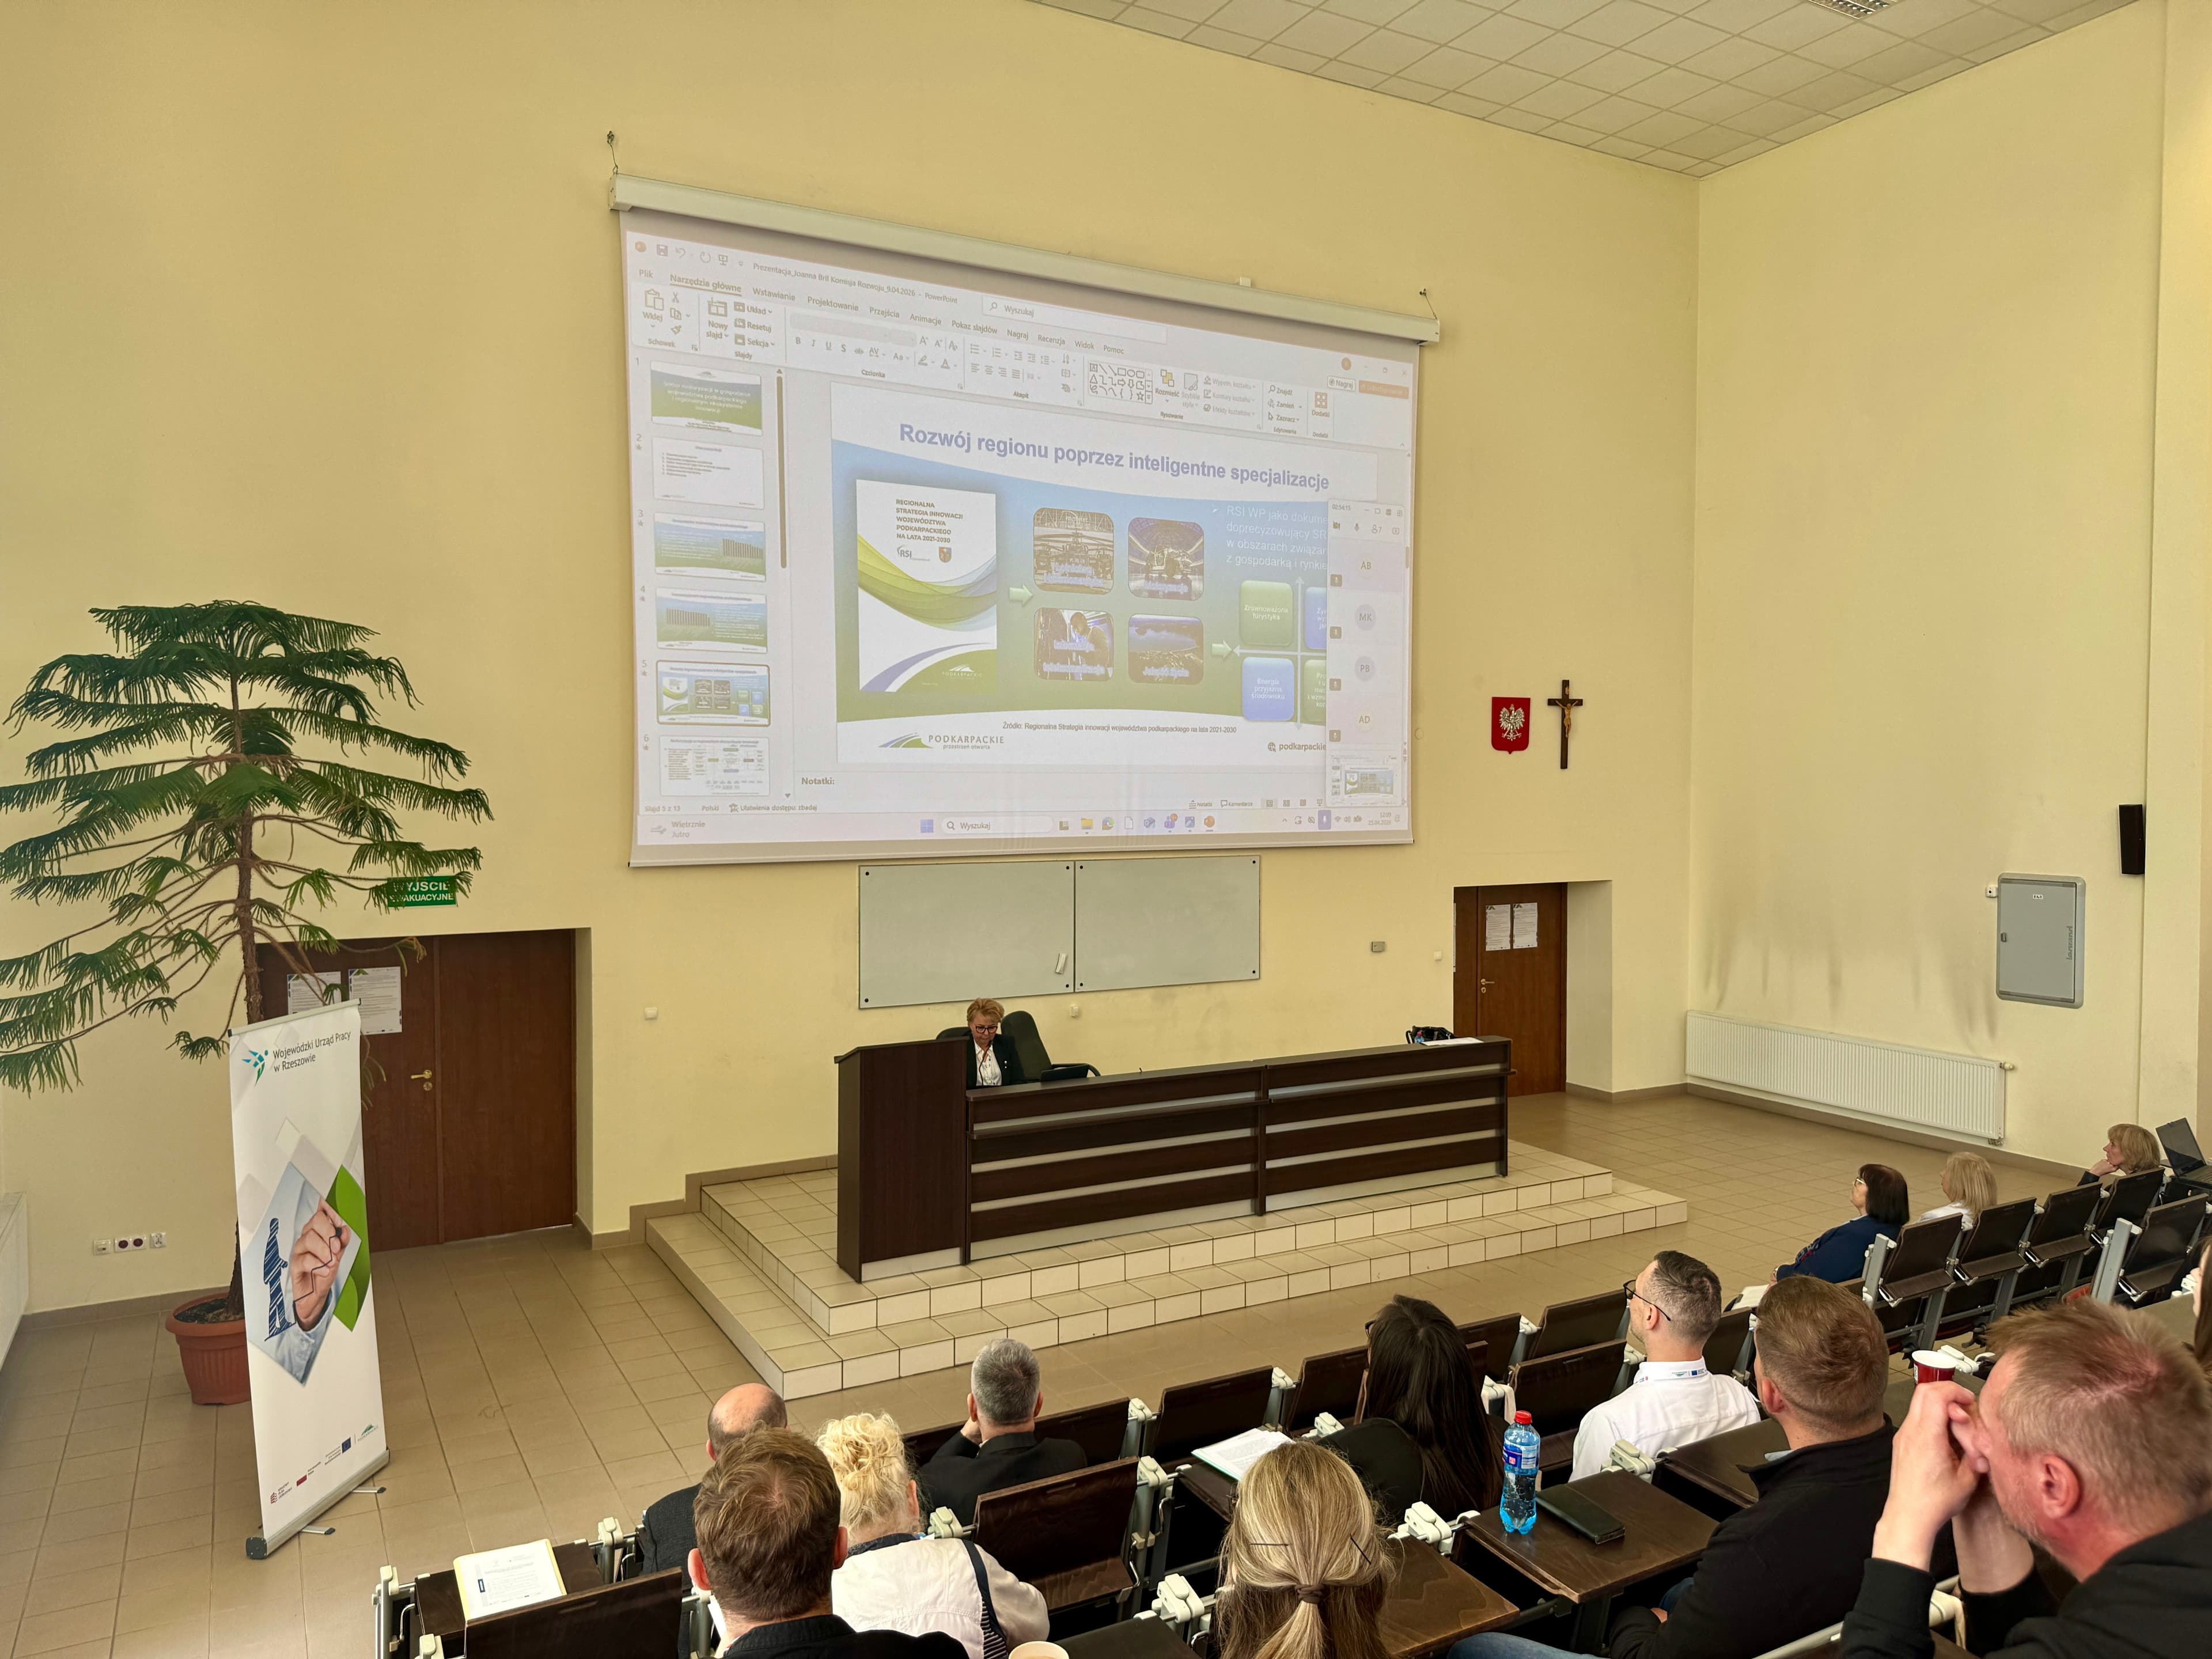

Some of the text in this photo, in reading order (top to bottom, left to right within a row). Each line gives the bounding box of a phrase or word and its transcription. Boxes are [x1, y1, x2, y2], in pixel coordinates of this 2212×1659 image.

[639, 269, 653, 278] Plik
[670, 274, 741, 292] Narzędzia główne
[752, 287, 796, 301] Wstawianie
[830, 276, 856, 287] Komisja
[925, 292, 959, 304] PowerPoint
[808, 296, 859, 312] Projektowanie
[869, 306, 900, 319] Przejścia
[1005, 305, 1034, 317] Wyszukaj
[642, 312, 662, 322] Wklej
[910, 313, 942, 326] Animacje
[708, 320, 728, 331] Nowy
[747, 322, 771, 332] Resetuj
[952, 320, 998, 335] Pokaz slajdów
[706, 331, 723, 339] slajd
[1007, 329, 1029, 341] Nagraj
[1037, 334, 1066, 346] Recenzja
[648, 338, 676, 347] Schowek
[747, 338, 769, 348] Sekcja
[1074, 340, 1095, 350] Widok
[734, 350, 752, 360] Slajdy
[1103, 345, 1124, 355] Pomoc
[1336, 380, 1353, 390] Nagraj
[1276, 414, 1296, 422] Zaznacz
[1312, 410, 1330, 418] Dodatki
[637, 433, 641, 441] 2
[900, 423, 1330, 492] Rozwój regionu poprzez inteligentne specjalizacje
[896, 499, 935, 507] REGIONALNA
[896, 507, 963, 520] STRATEGIA INNOWACJI
[1227, 505, 1244, 517] RSI
[1248, 507, 1266, 517] WP
[1268, 510, 1288, 521] jako
[896, 516, 946, 525] WOJEWÓDZTWA
[896, 525, 951, 535] PODKARPACKIEGO
[1227, 521, 1309, 541] doprecyzowujący
[1226, 539, 1235, 547] w
[1237, 539, 1287, 552] obszarach
[900, 550, 912, 559] RSI
[1235, 555, 1291, 570] gospodarką
[1360, 561, 1372, 570] AB
[1359, 613, 1373, 622] MK
[642, 660, 647, 668] 5
[1360, 665, 1370, 673] PB
[1358, 715, 1370, 724] AD
[1003, 721, 1024, 729] Źródło:
[1024, 723, 1057, 731] Regionalna
[643, 733, 650, 742] 6
[929, 735, 1005, 744] PODKARPACKIE
[960, 821, 991, 831] Wyszukaj
[273, 1031, 351, 1059] Wojewódzki Urząd Pracy
[282, 1053, 316, 1071] Rzeszowie
